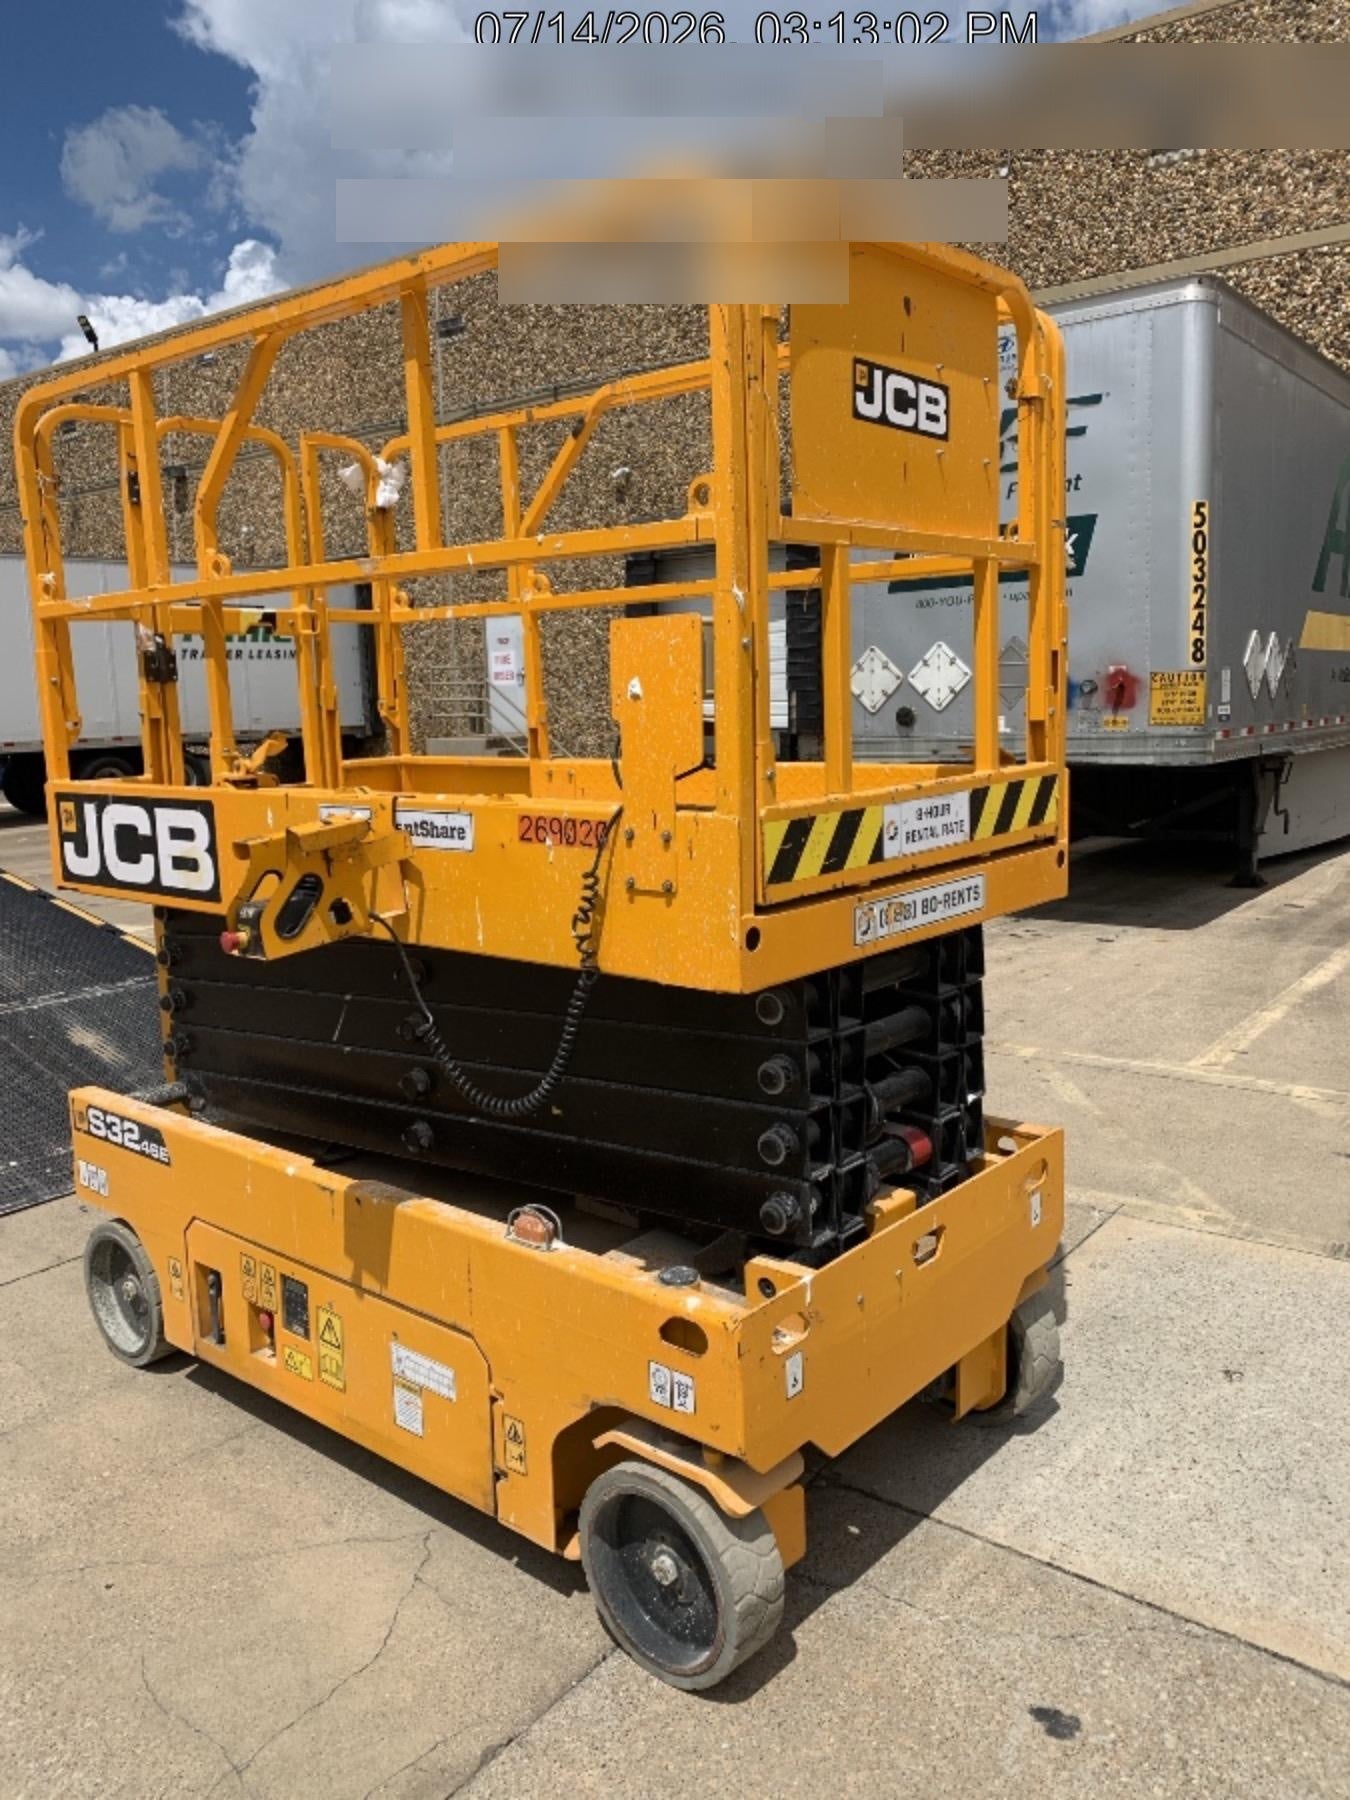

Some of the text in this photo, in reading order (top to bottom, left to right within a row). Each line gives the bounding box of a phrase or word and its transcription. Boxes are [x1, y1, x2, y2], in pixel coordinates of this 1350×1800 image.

[855, 368, 947, 435] JCB
[1191, 501, 1207, 664] 503248
[248, 649, 297, 660] LEASIN
[63, 802, 215, 892] JCB
